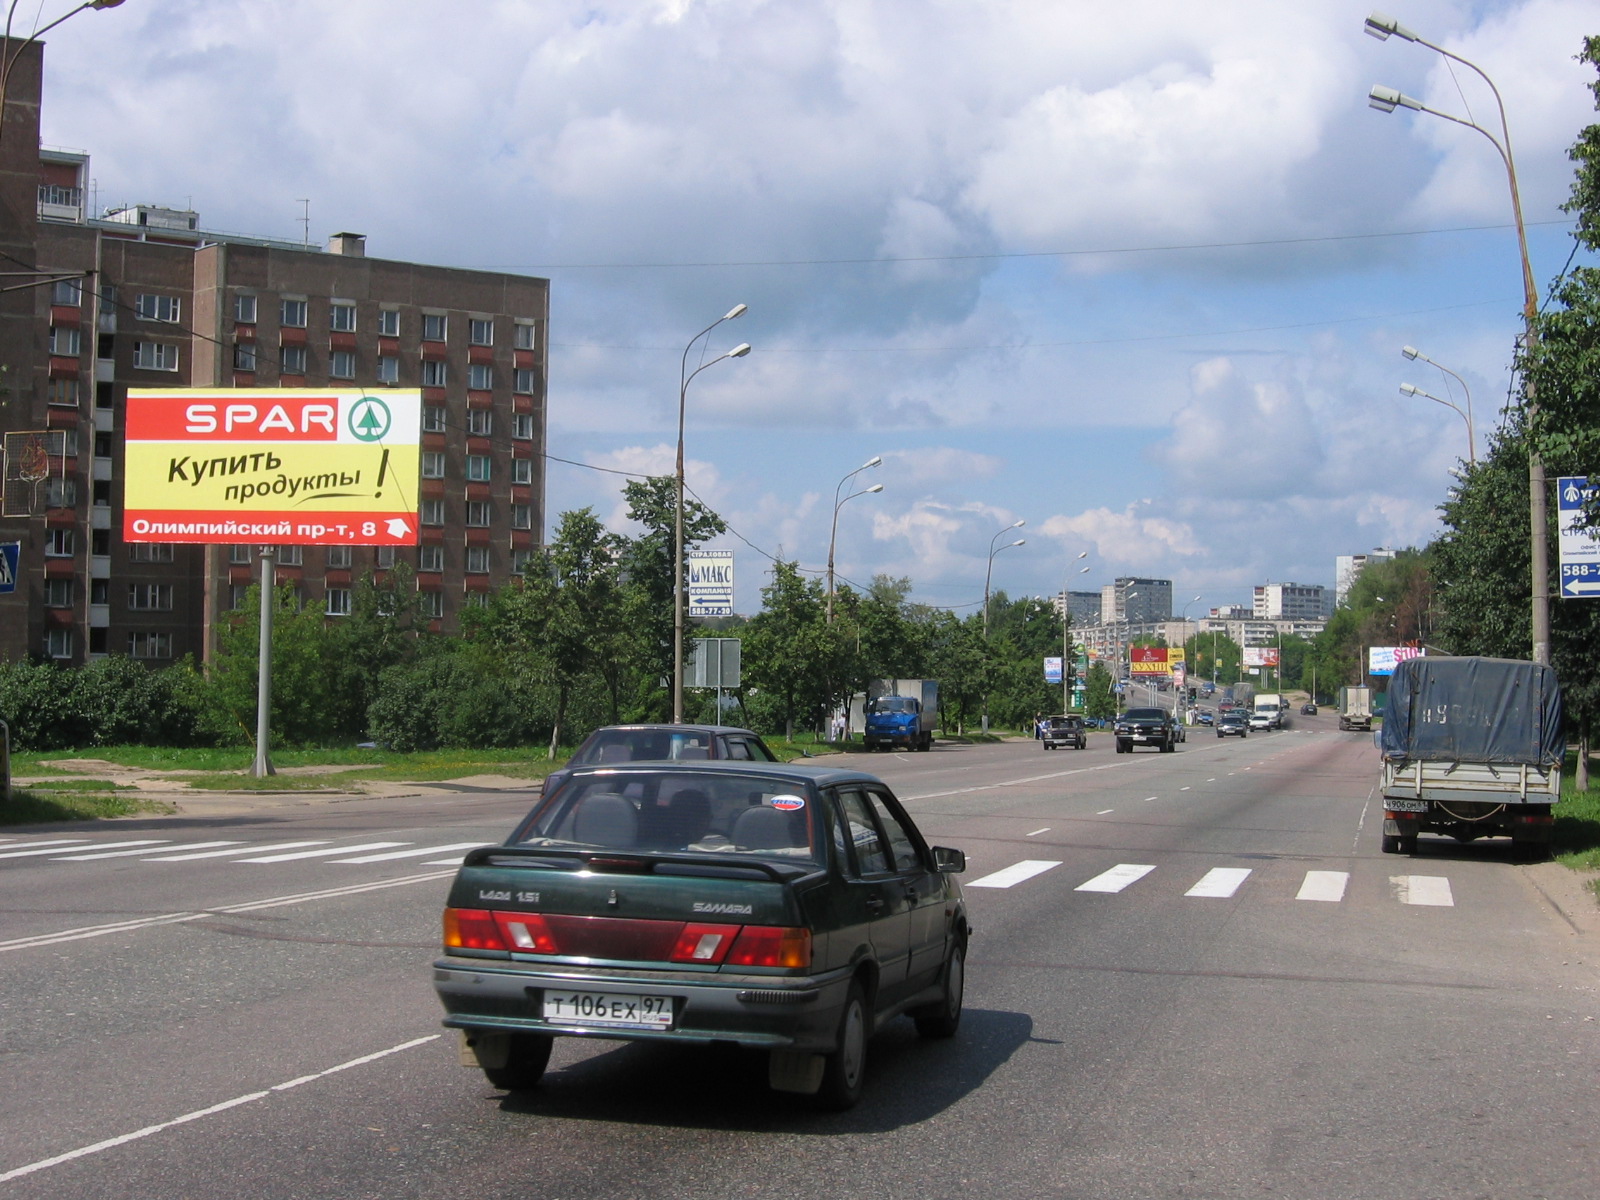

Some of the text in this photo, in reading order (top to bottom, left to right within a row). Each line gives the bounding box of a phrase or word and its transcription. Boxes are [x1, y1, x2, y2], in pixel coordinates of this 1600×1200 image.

[185, 404, 335, 433] SPAR
[168, 451, 282, 486] Купить
[224, 470, 361, 503] продукты
[132, 519, 376, 539] Олимпийский пр-т, 8
[701, 566, 731, 582] МАКС
[1132, 662, 1168, 671] КУХНИ
[479, 889, 512, 901] LADA
[692, 902, 753, 915] SAMARA
[643, 997, 665, 1015] 97
